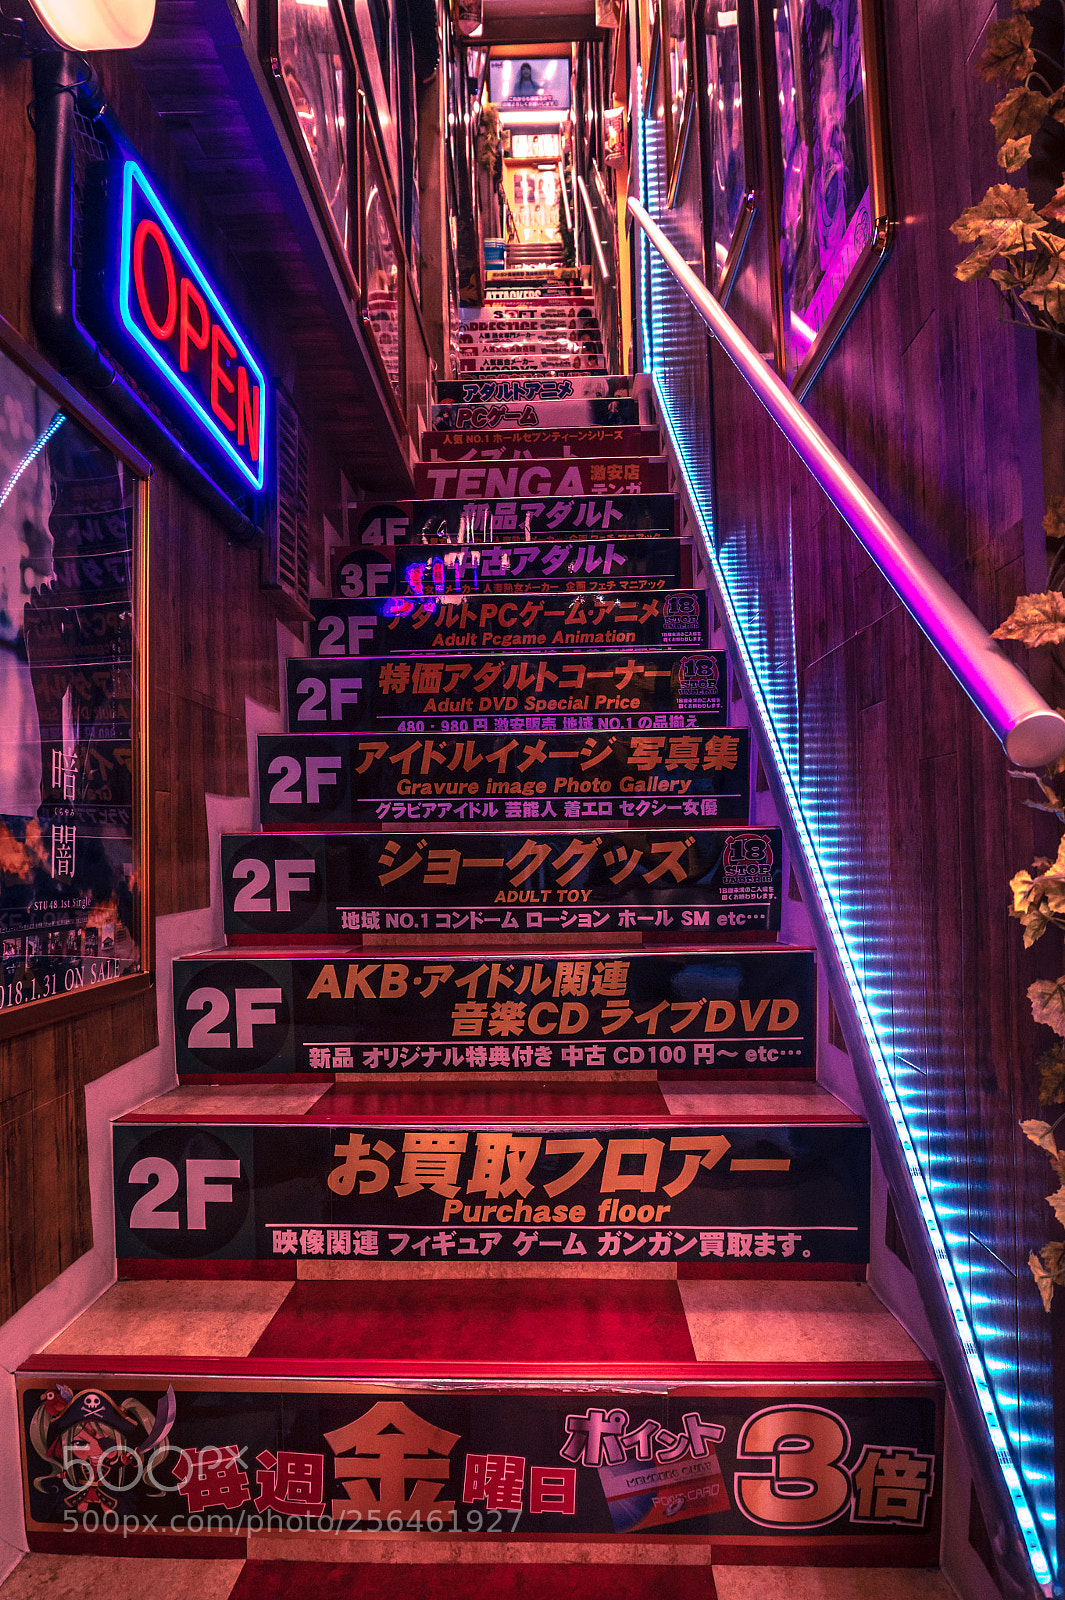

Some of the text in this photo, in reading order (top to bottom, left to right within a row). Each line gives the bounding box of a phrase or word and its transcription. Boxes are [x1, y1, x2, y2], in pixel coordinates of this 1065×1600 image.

[133, 219, 260, 461] OPEN
[462, 380, 574, 402] アダルトアニメ
[455, 404, 539, 428] PCゲーム
[443, 434, 463, 445] 人気
[466, 434, 489, 443] NO.1
[426, 466, 585, 499] TENGA
[590, 464, 640, 481] 激安店
[361, 517, 410, 546] 4F
[340, 563, 392, 597] 3F
[566, 580, 586, 592] 企画
[589, 580, 616, 590] フェチ
[619, 579, 666, 590] マニアック
[388, 598, 660, 630] ダルトPCゲーム・アニメ
[317, 615, 378, 656] 2F
[432, 630, 636, 647] Adult Pcgame Animation
[378, 659, 672, 695] 特価アダルトコーナー
[684, 659, 714, 677] 18
[296, 677, 363, 721] 2F
[423, 694, 641, 713] Adult DVD Special Price
[562, 715, 594, 730] 地域
[355, 735, 740, 775] アイドルイメージ 写真集
[267, 755, 342, 804] 2F
[397, 775, 693, 797] Gravure image Photo Gallery
[375, 798, 718, 820] グラビアアイドル 芸能人 着エロ セクシー女優
[377, 836, 697, 888] ジョークグッズ
[730, 838, 768, 861] 18
[724, 863, 772, 876] STOP
[232, 858, 315, 912] 2F
[494, 889, 593, 903] ADULT TOY
[34, 900, 58, 911] STU48
[72, 896, 92, 909] Single
[341, 911, 380, 930] 地域
[385, 912, 428, 929] NO.1
[435, 911, 520, 929] コンドーム
[526, 910, 611, 928] ローション
[618, 909, 674, 928] ホール
[681, 910, 710, 927] SM
[64, 965, 85, 991] ON
[90, 957, 121, 985] SALE
[306, 960, 631, 1000] AKB・アイドル関連
[185, 986, 283, 1049] 2F
[451, 996, 800, 1037] 音楽CD ライブDVD
[308, 1046, 354, 1069] 新品
[362, 1045, 553, 1069] オリジナル特典付き
[561, 1045, 607, 1067] 中古
[327, 1132, 791, 1199] お買取フロアー
[128, 1156, 241, 1230] 2F
[441, 1198, 671, 1224] Purchase floor
[272, 1229, 812, 1258] 映像関連 フィギュア ゲーム ガンガン買取ます。
[559, 1406, 726, 1468] ポイント
